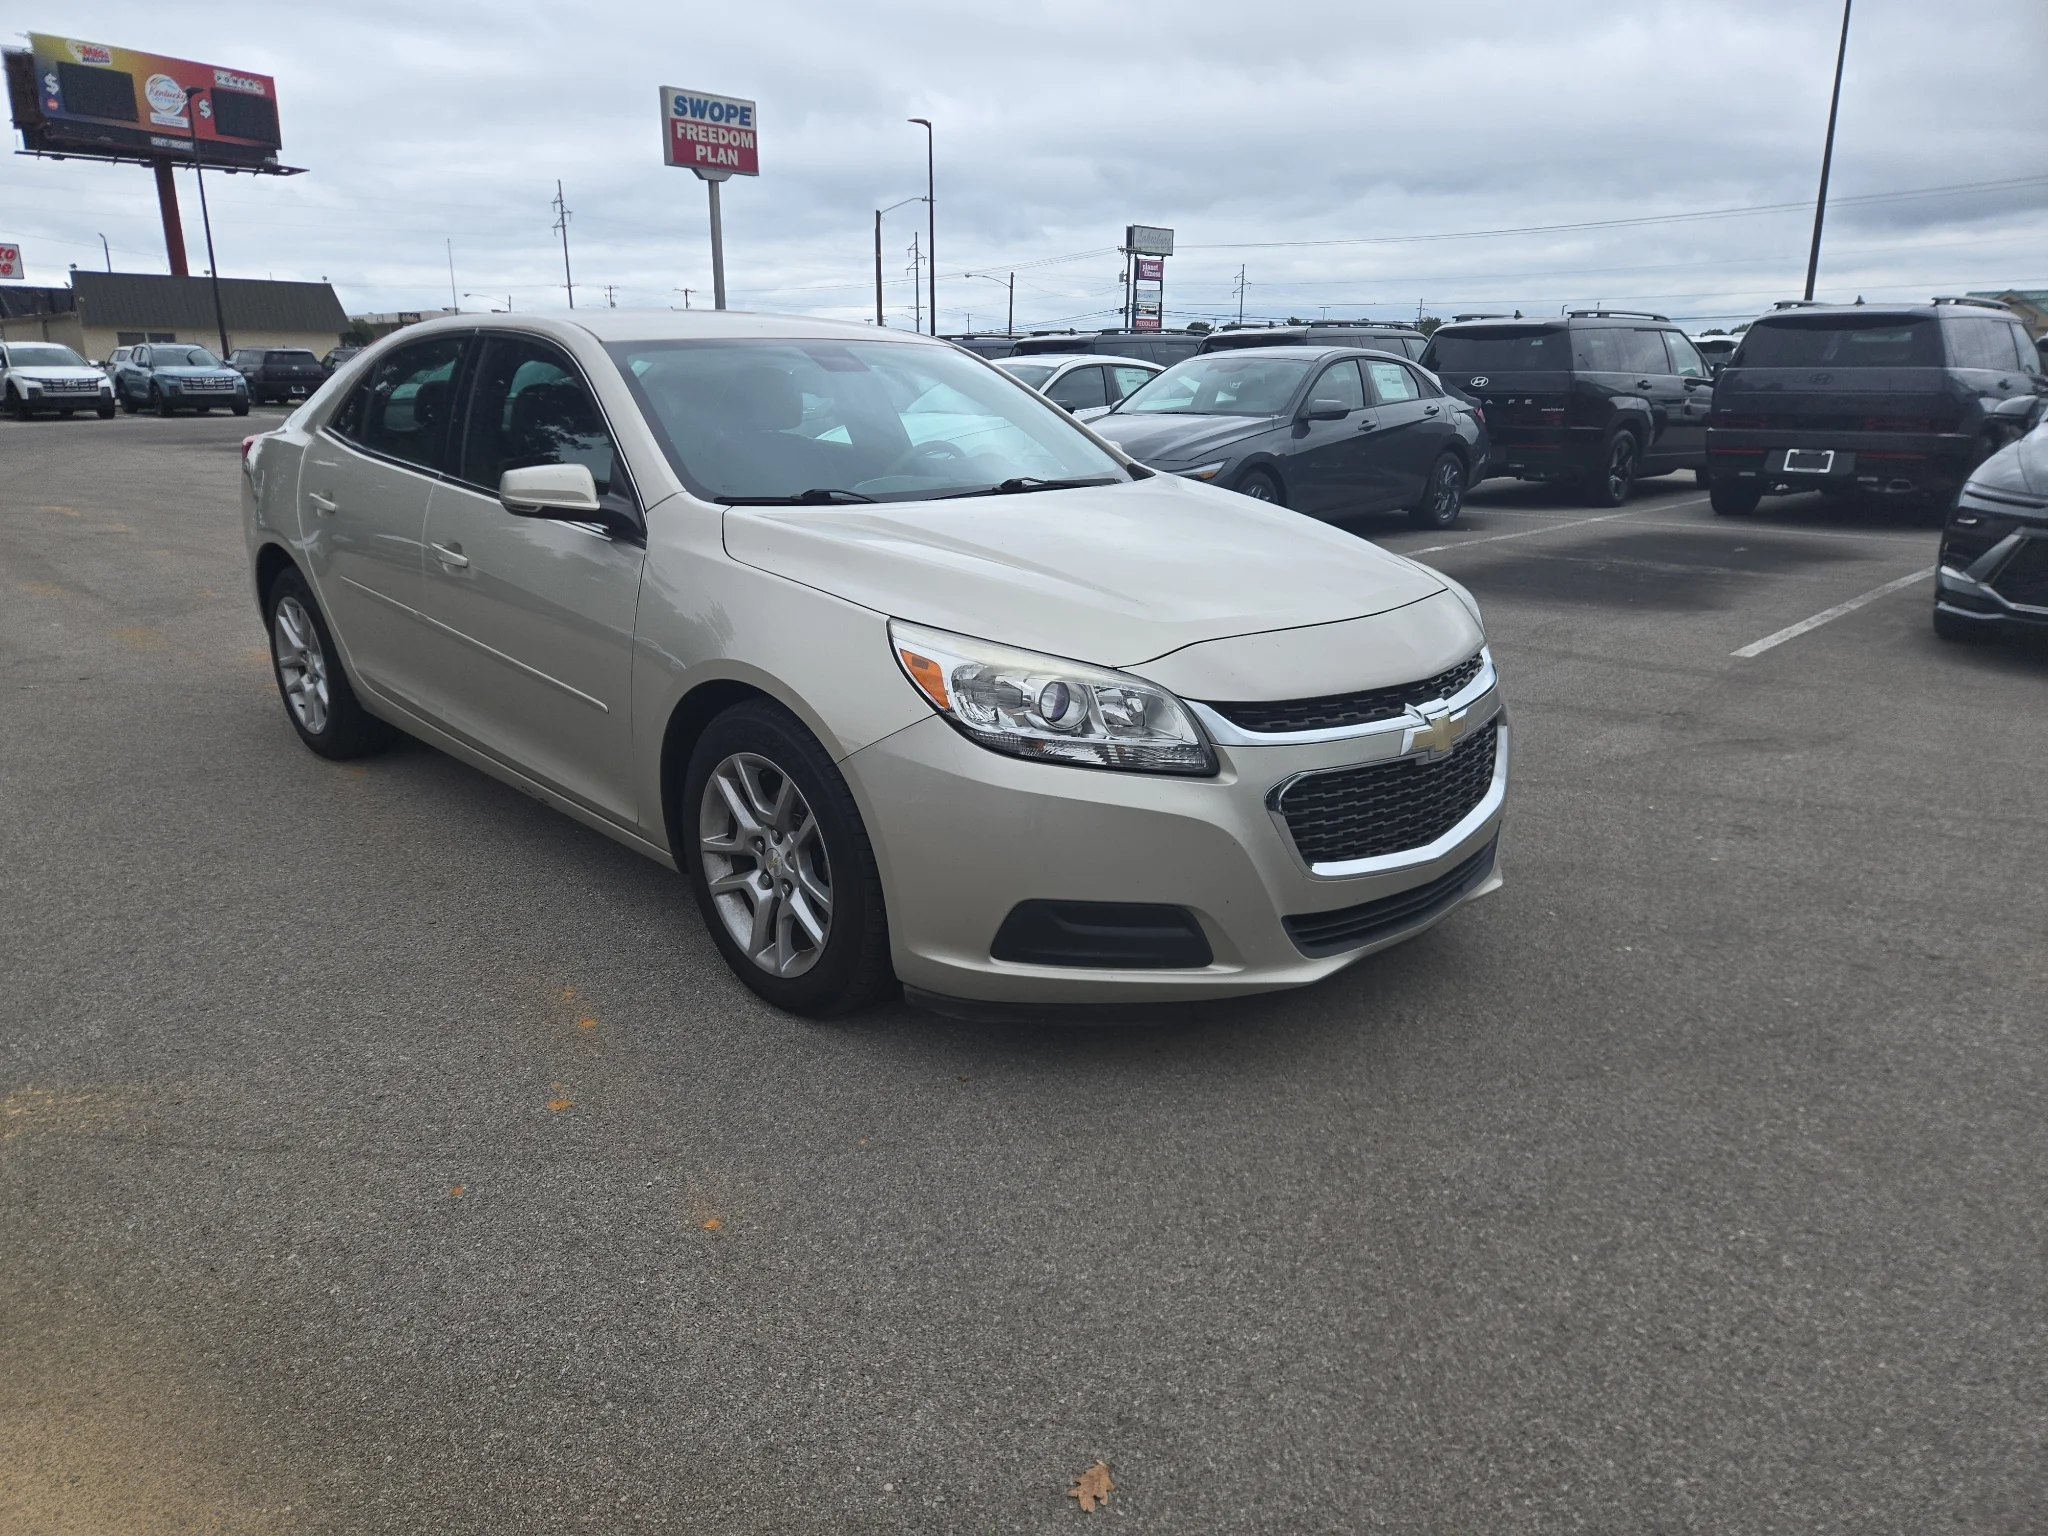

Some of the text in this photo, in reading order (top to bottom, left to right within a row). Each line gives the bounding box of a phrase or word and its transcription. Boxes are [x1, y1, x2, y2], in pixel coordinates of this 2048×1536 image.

[44, 73, 60, 95] $
[148, 85, 187, 104] Kentucky
[198, 99, 212, 119] $
[673, 94, 752, 127] SWOPE
[675, 121, 754, 149] FREEDOM
[695, 144, 739, 166] PLAN
[1142, 263, 1159, 272] planet
[1144, 270, 1161, 278] fitness
[1136, 320, 1159, 328] PEDDLERS
